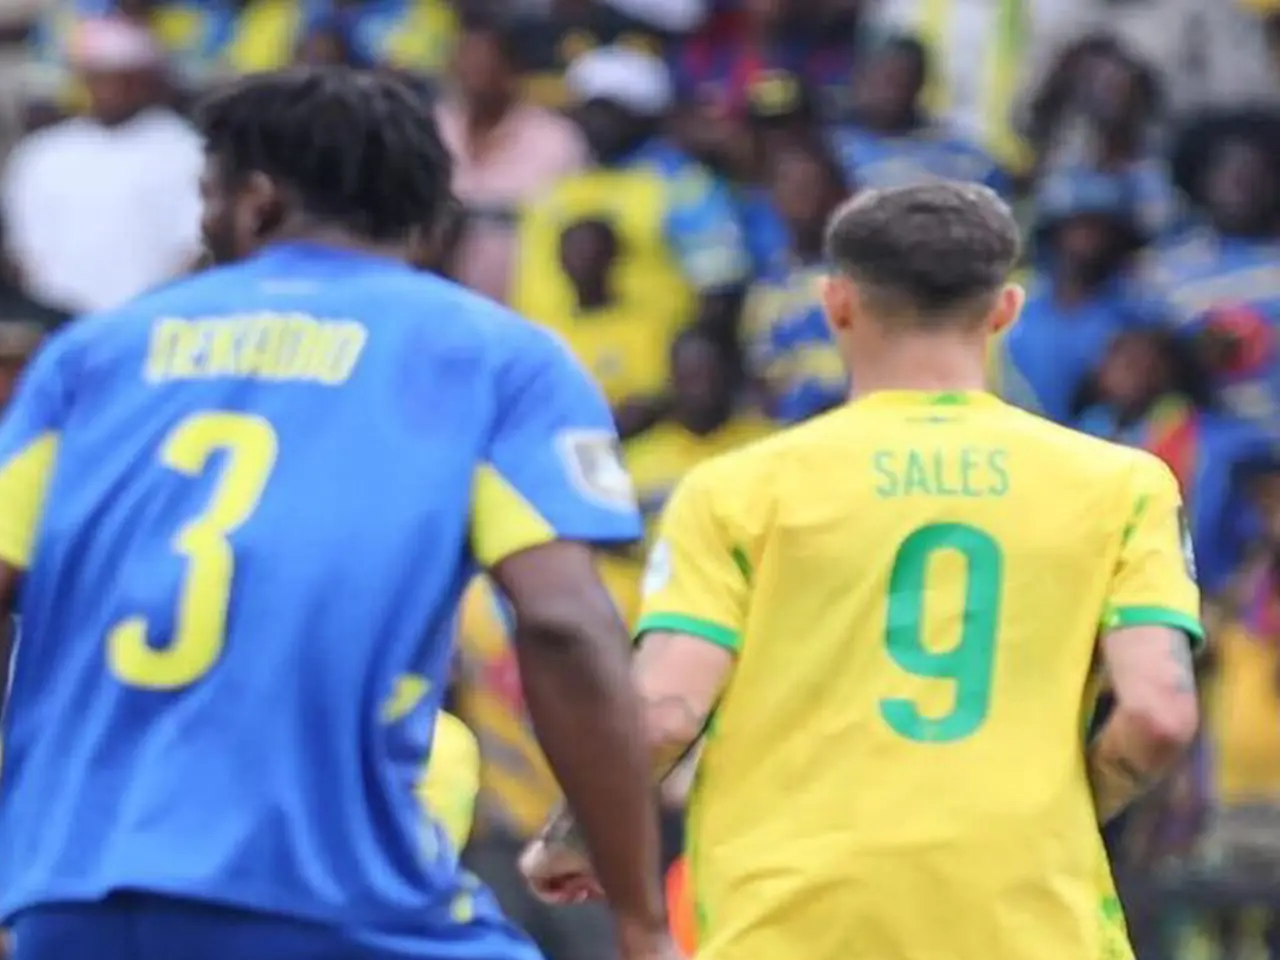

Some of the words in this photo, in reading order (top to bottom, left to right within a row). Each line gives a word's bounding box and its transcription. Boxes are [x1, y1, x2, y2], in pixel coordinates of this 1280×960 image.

[105, 410, 280, 690] 3
[873, 447, 1011, 499] SALES
[878, 520, 1004, 744] 9
